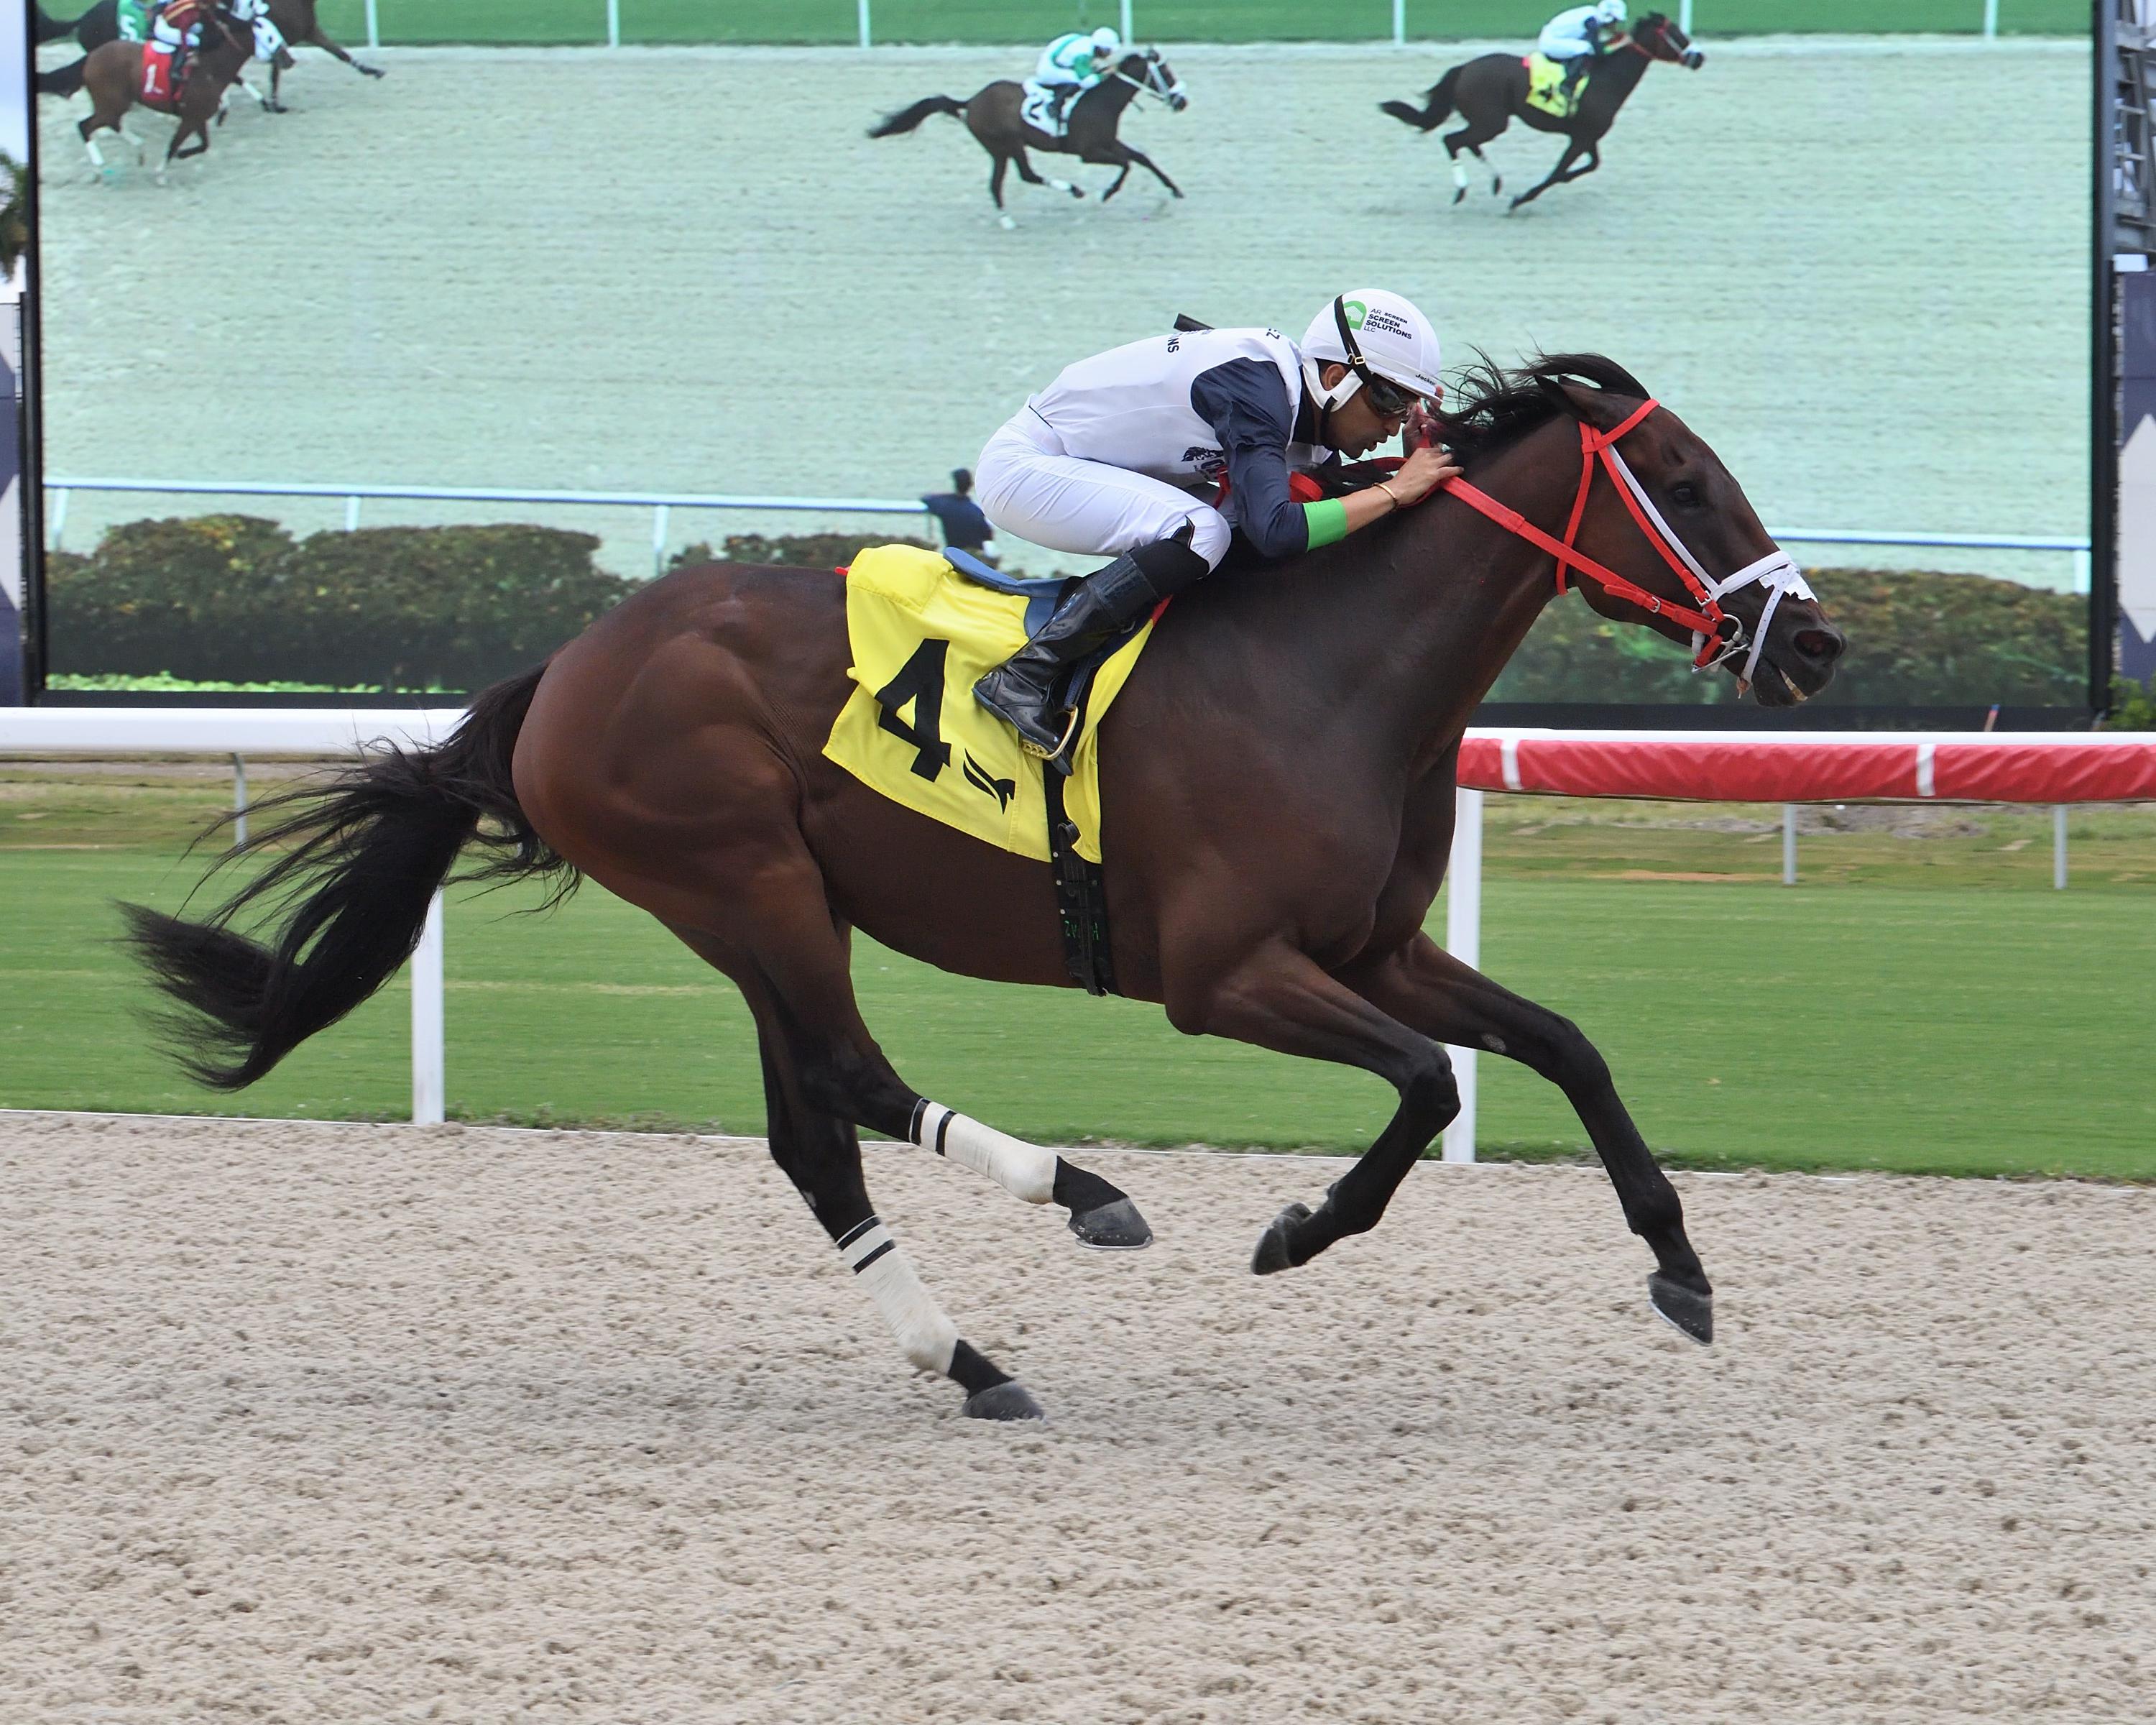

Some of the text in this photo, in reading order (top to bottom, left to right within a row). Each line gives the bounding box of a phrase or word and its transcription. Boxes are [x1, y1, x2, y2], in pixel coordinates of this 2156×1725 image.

[120, 14, 138, 42] 5
[144, 63, 164, 93] 1
[1368, 313, 1401, 328] SCREEN
[1384, 312, 1408, 323] SCREEN
[1365, 320, 1412, 339] SOLUTIONS
[875, 638, 952, 782] 4
